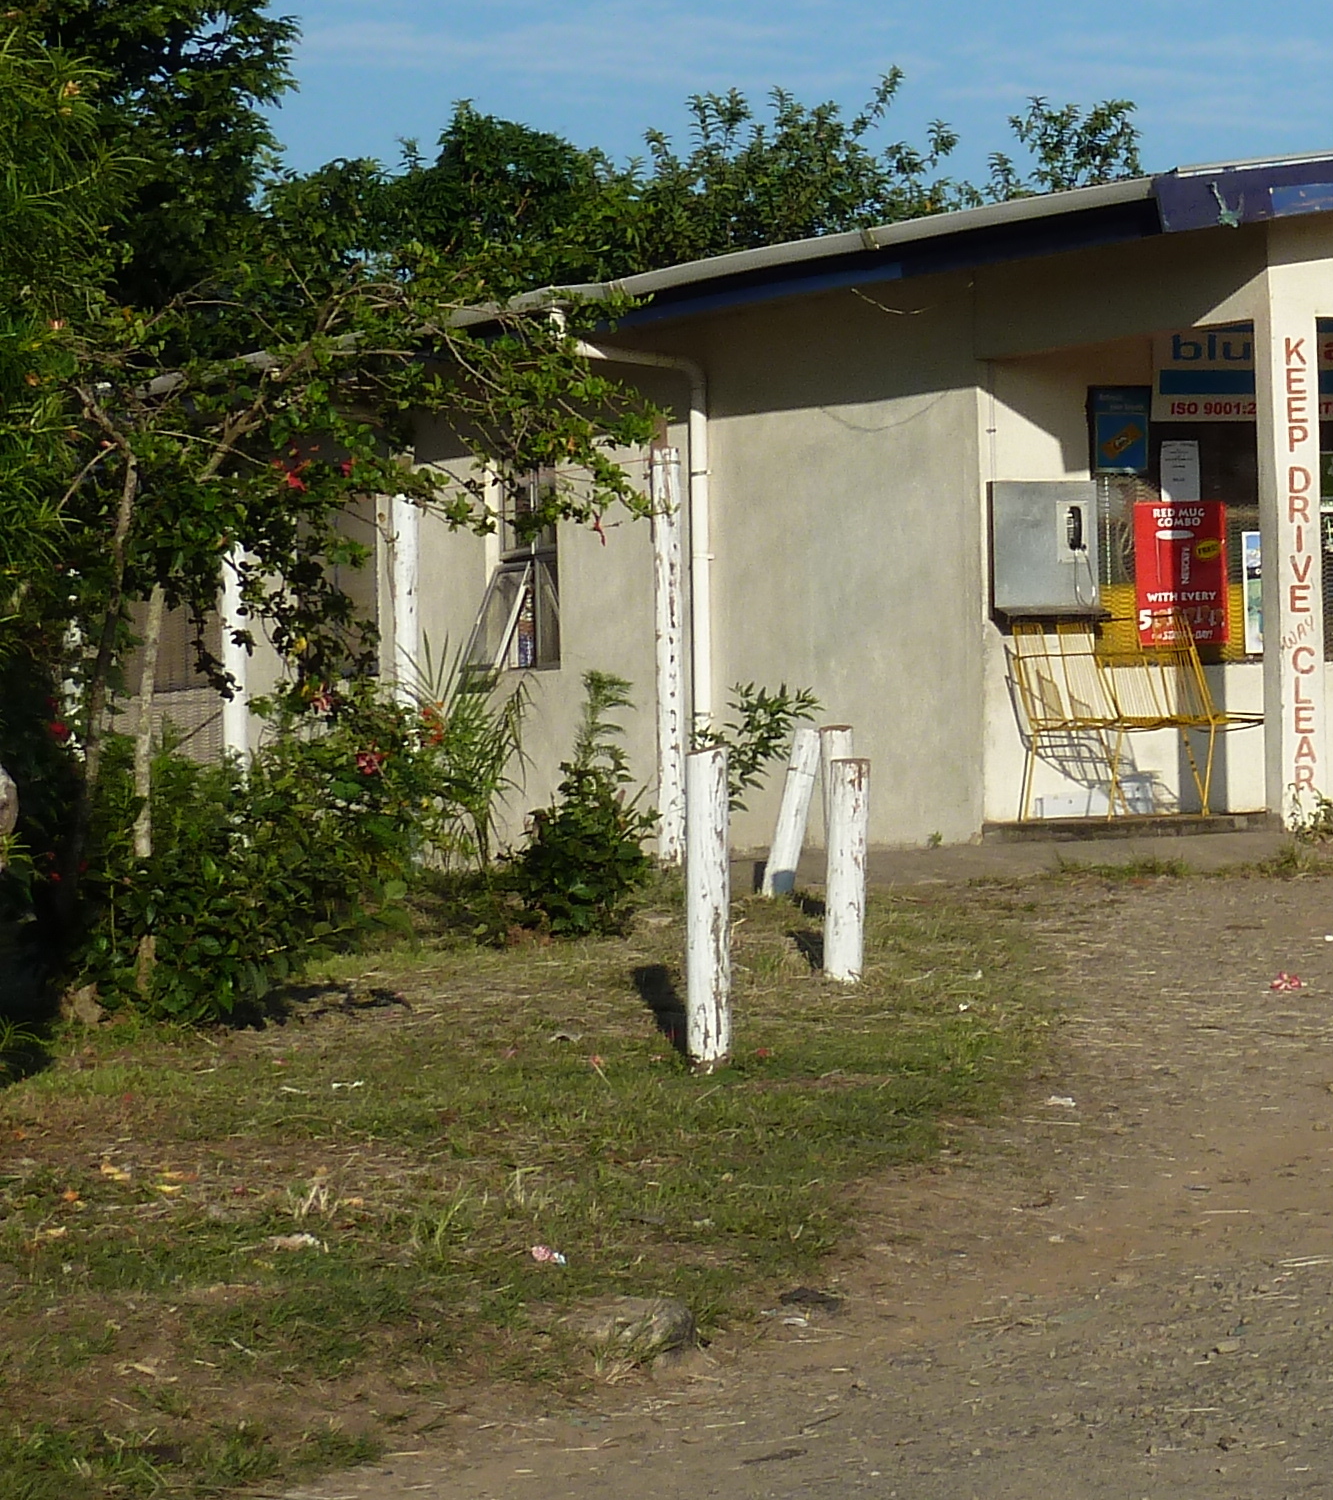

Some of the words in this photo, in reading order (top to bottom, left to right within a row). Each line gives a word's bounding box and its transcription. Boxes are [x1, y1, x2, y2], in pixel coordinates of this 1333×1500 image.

[1285, 337, 1309, 452] KEEP
[1170, 402, 1198, 415] ISO
[1152, 508, 1175, 518] RED
[1179, 508, 1206, 518] MUG
[1157, 518, 1201, 528] COMBO
[1288, 466, 1312, 612] DRIVE
[1146, 592, 1178, 603] WITH
[1181, 592, 1217, 601] EVERY
[1140, 609, 1152, 630] 5
[1282, 615, 1314, 650] WAY
[1292, 646, 1316, 793] CLEAR
